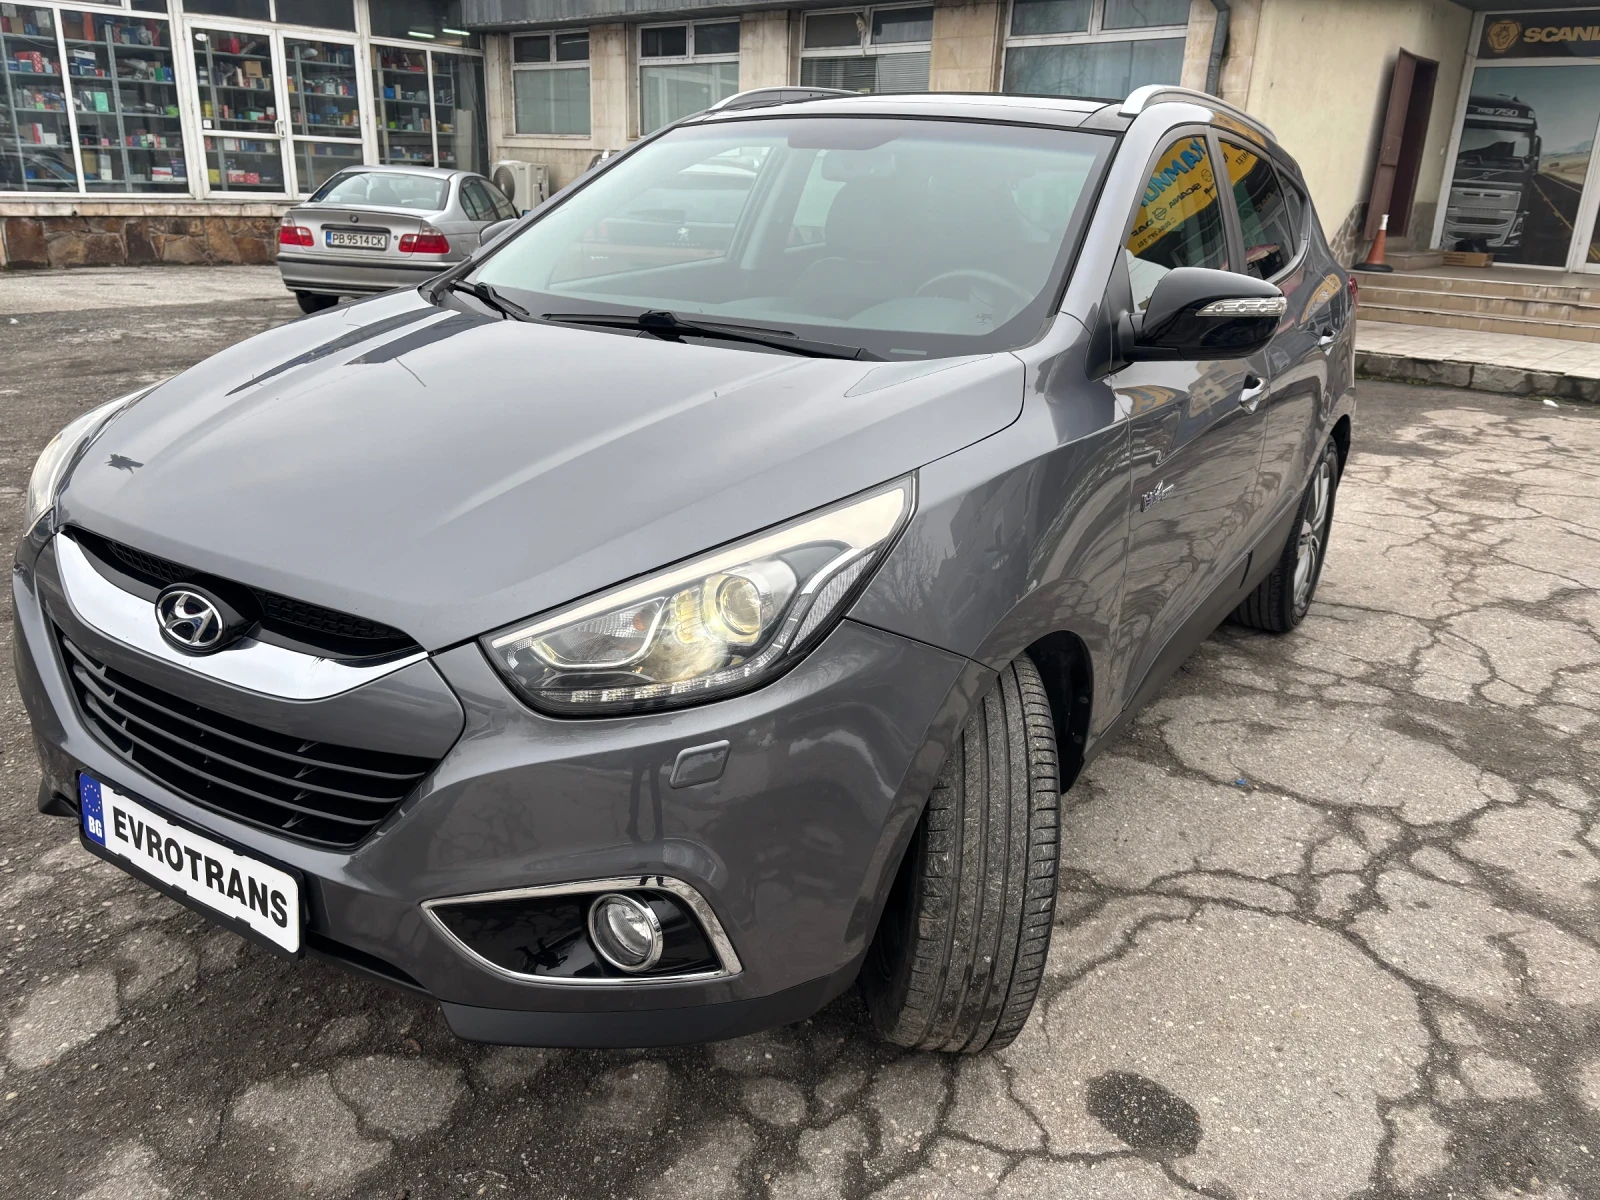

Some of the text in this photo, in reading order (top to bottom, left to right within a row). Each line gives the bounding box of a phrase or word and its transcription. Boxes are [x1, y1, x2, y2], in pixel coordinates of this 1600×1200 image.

[1523, 26, 1600, 43] SCANI
[332, 233, 383, 247] PB 9514 CK
[88, 815, 103, 838] BG
[113, 805, 288, 928] EVROTRANS
